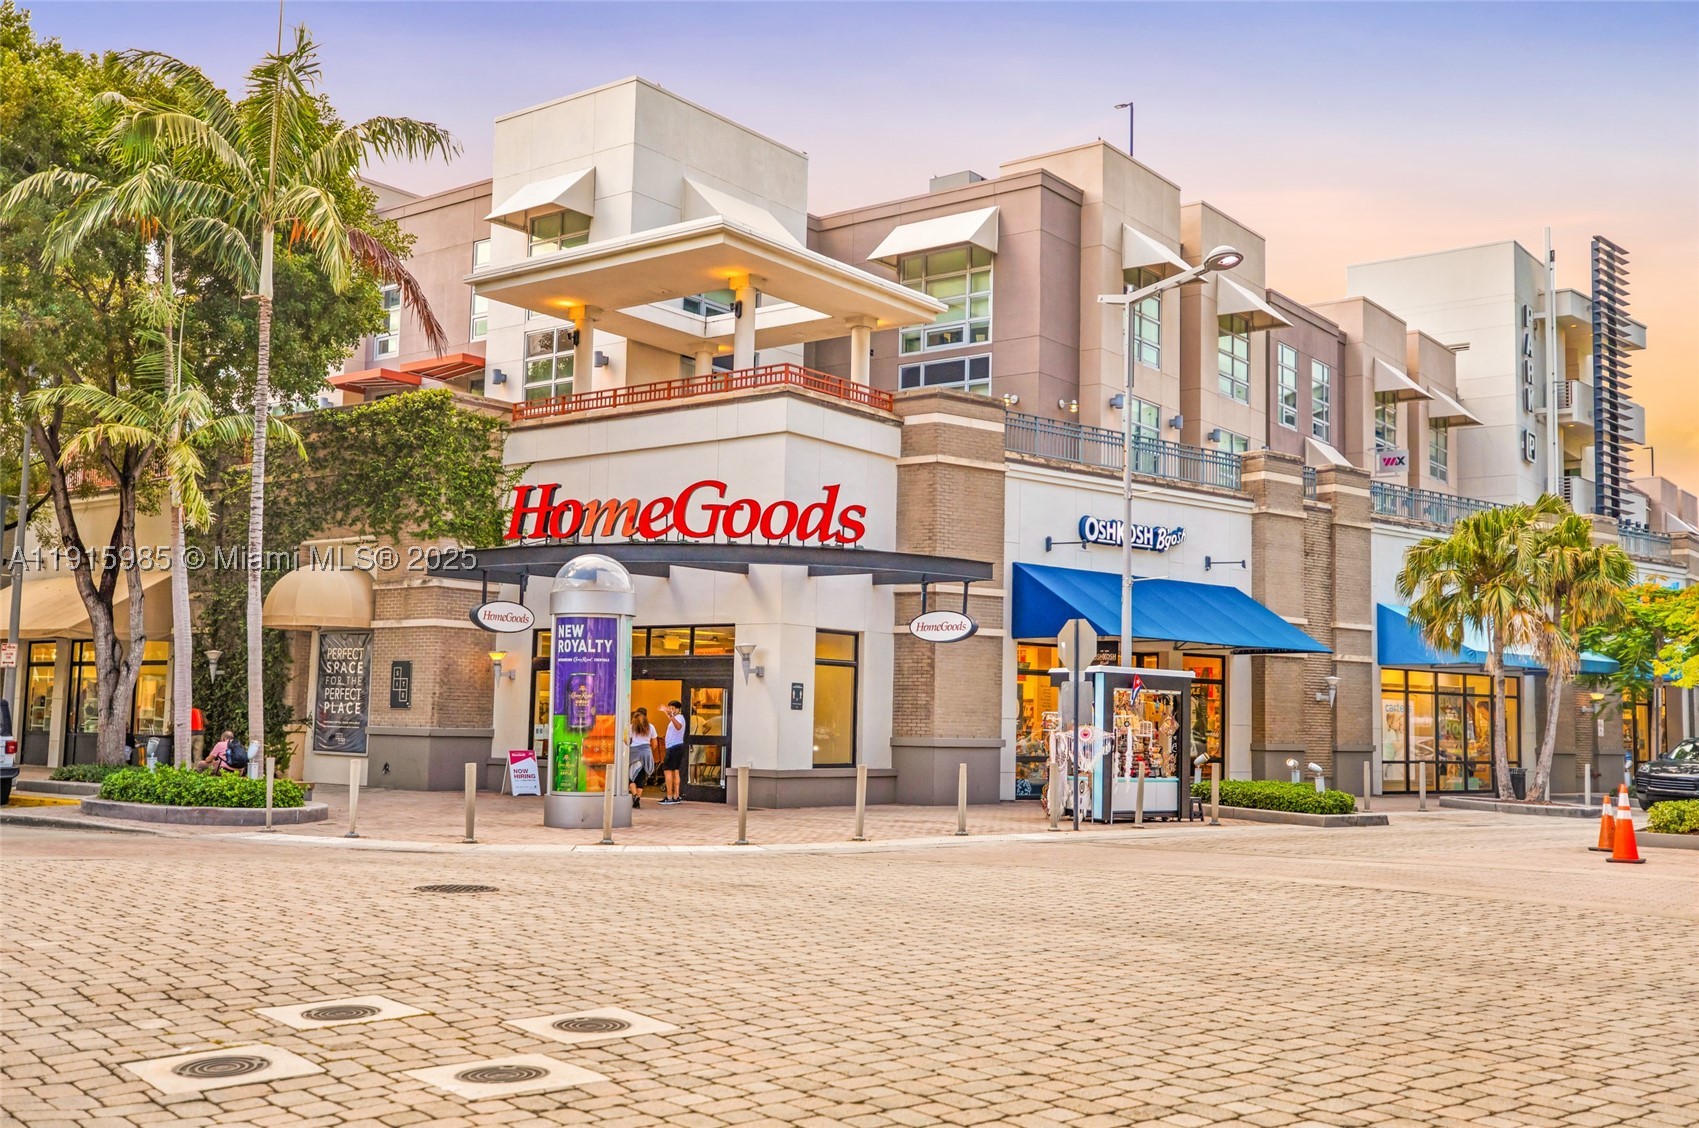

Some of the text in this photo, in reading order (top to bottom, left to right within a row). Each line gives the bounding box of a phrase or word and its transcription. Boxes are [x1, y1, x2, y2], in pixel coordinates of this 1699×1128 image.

[504, 480, 867, 543] HomeGoods
[483, 610, 529, 624] HomeGoods
[558, 625, 584, 638] NEW
[916, 621, 967, 632] HomeGoods
[558, 639, 613, 653] ROYALTY
[327, 647, 364, 660] PERFECT
[326, 661, 364, 674] SPACE
[325, 676, 362, 686] FOR THE
[324, 687, 362, 701] PERFECT
[323, 701, 361, 714] PLACE
